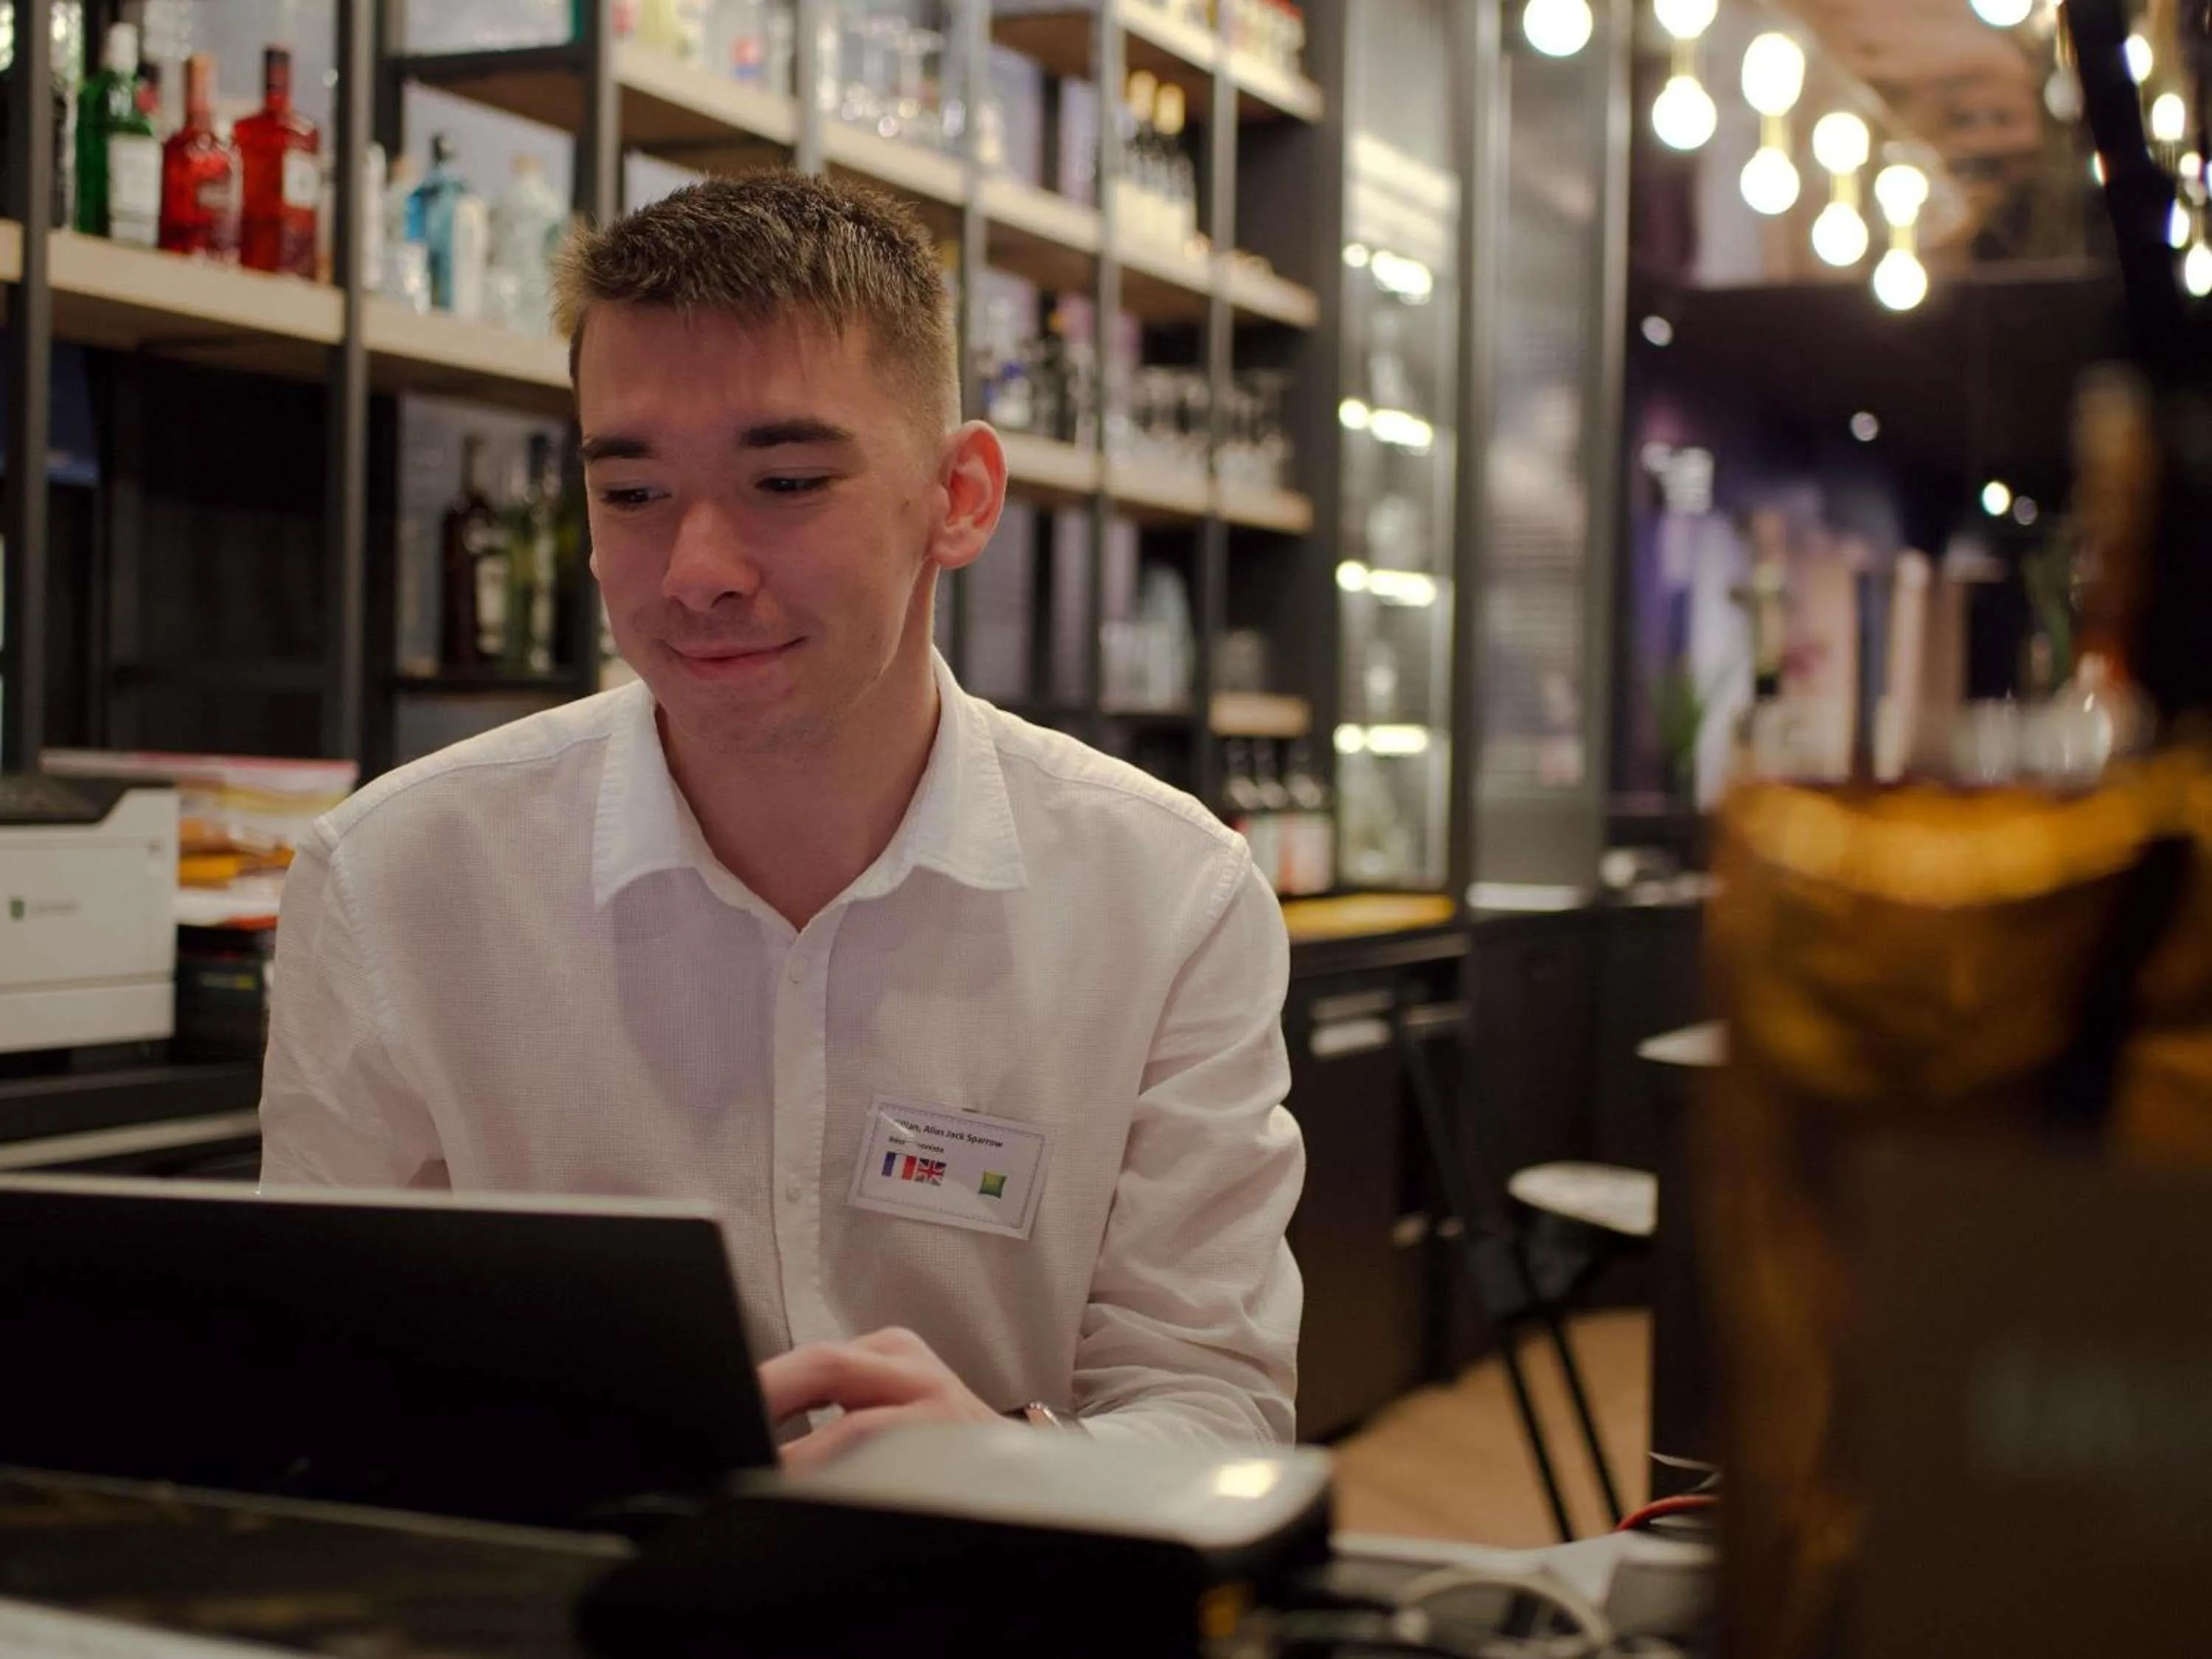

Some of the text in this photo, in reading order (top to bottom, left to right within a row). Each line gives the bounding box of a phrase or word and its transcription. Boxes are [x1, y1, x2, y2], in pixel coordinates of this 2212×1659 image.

[922, 1124, 945, 1136] Alias
[945, 1129, 964, 1141] Jack
[967, 1133, 1004, 1148] Sparrow
